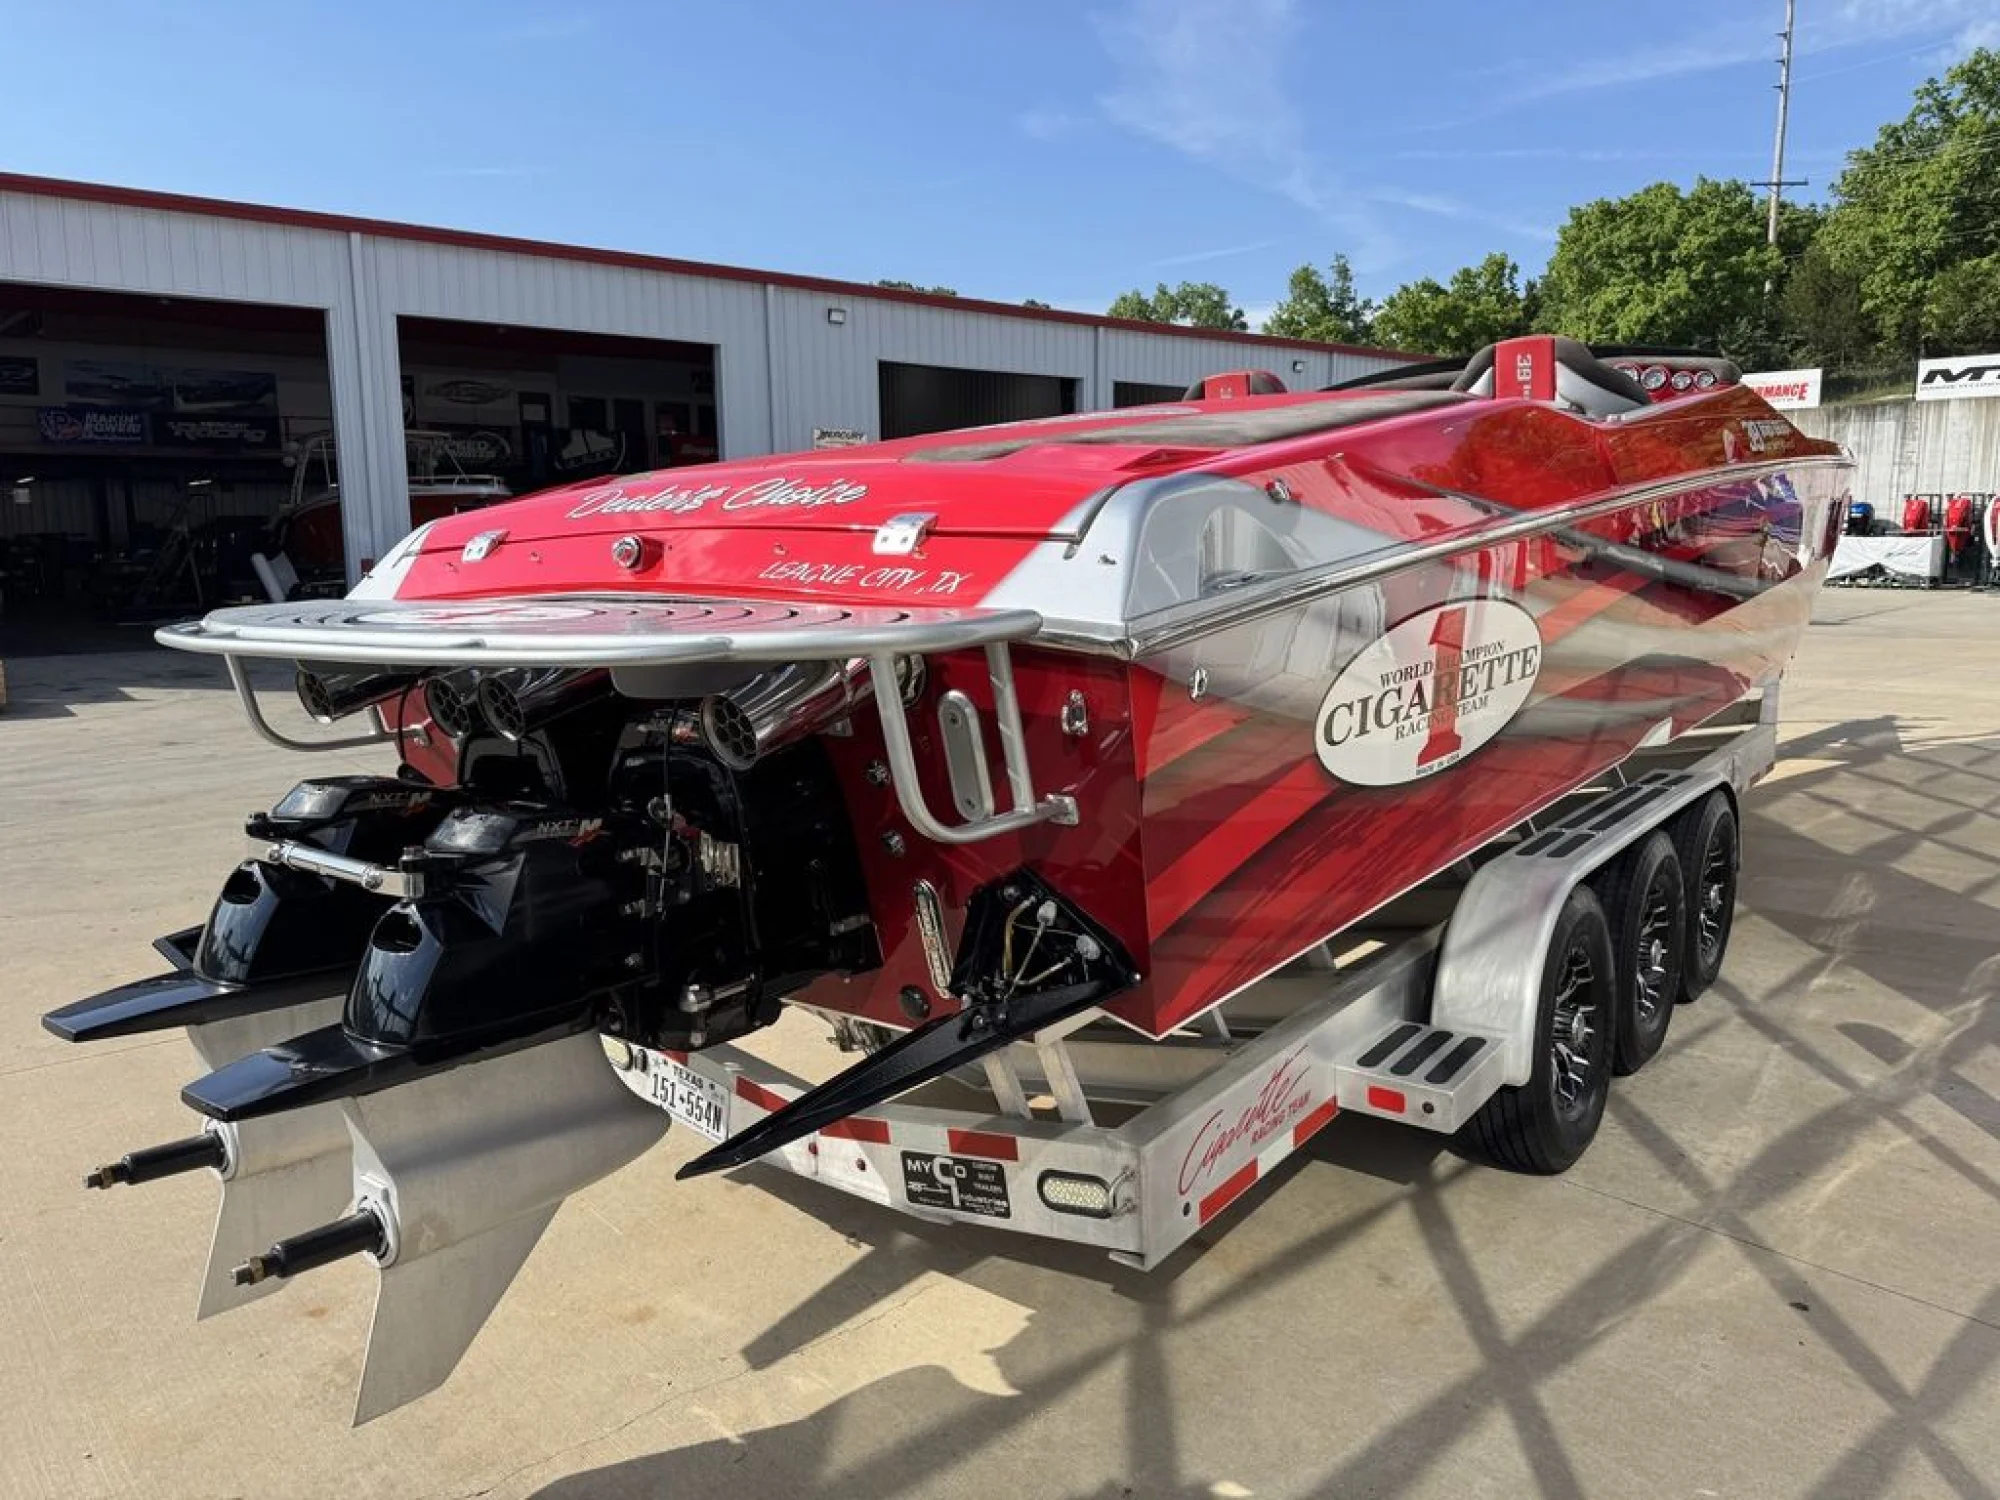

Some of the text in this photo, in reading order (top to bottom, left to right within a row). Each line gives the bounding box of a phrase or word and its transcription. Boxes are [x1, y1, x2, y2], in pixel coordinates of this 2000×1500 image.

[722, 477, 869, 510] Choice
[758, 560, 865, 585] LEAGUE
[930, 571, 974, 594] TX
[1380, 659, 1434, 689] WORLD
[1323, 644, 1539, 747] CIGARETTE
[1456, 694, 1490, 718] TEAM
[673, 1064, 704, 1090] TEXAS
[1250, 1089, 1312, 1147] RACING TEAM
